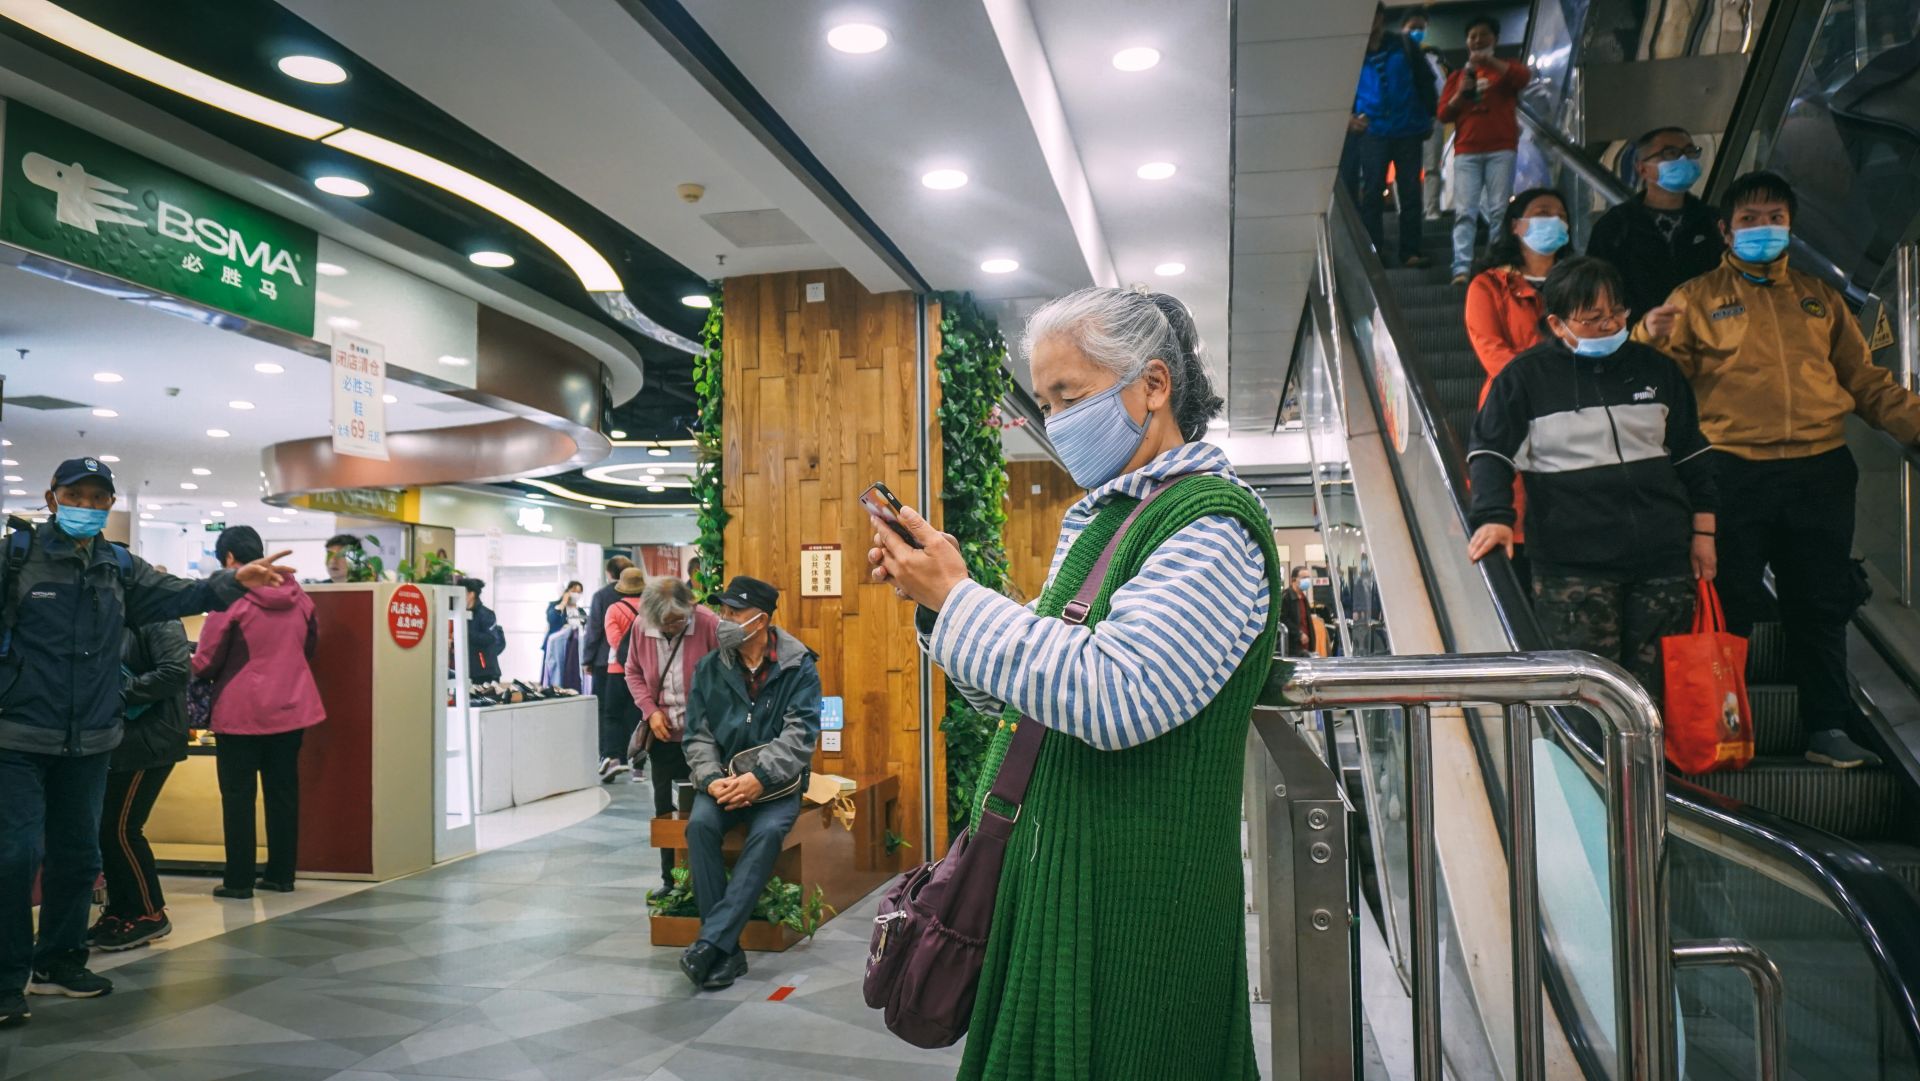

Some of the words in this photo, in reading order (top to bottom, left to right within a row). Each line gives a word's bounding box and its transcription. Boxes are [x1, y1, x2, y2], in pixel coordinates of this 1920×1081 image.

[156, 200, 303, 286] BSMA
[181, 252, 279, 301] 必胜马
